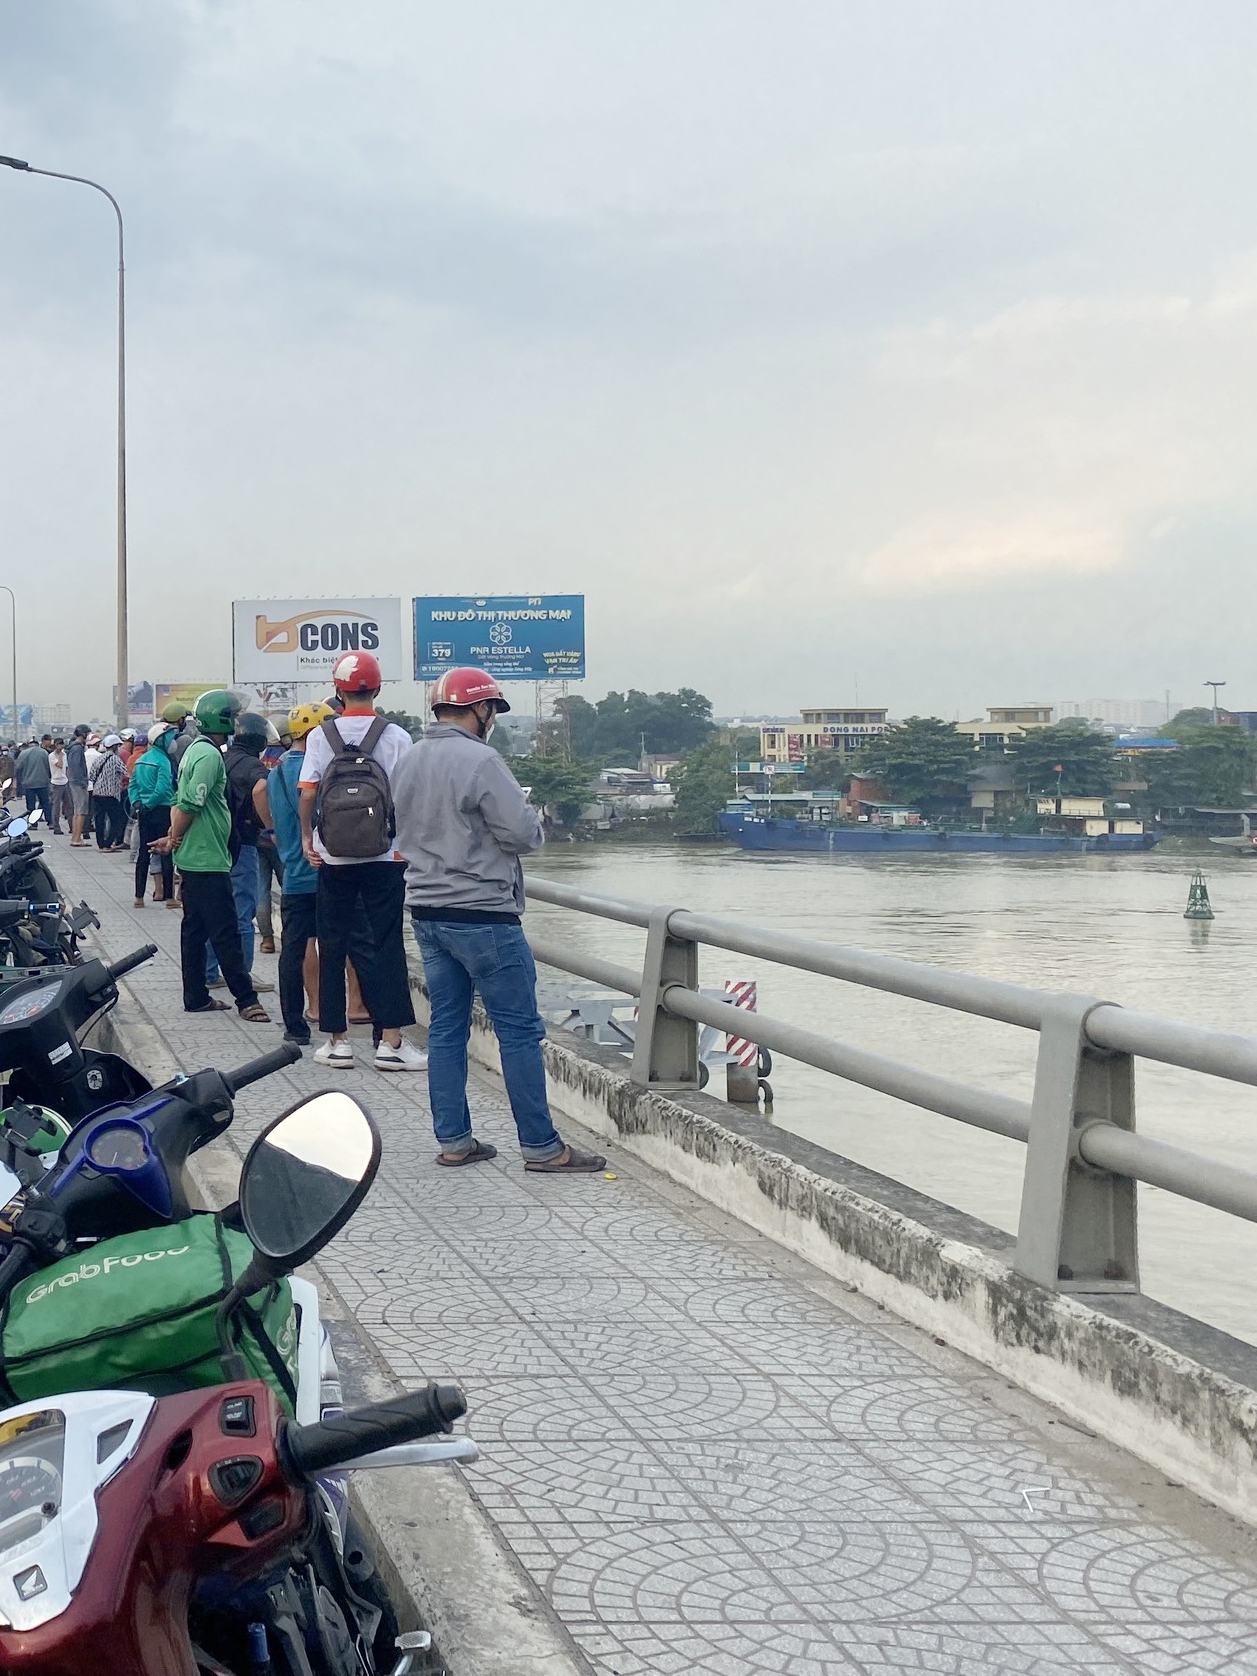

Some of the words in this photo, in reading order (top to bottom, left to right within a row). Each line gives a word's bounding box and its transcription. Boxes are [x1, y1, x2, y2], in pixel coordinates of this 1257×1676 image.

[431, 610, 456, 621] KHU
[457, 609, 475, 621] ĐÔ
[476, 610, 496, 623] THỊ
[497, 609, 548, 620] THƯƠNG
[548, 609, 572, 621] MẠI
[432, 649, 451, 657] 379
[470, 646, 489, 654] PNR
[491, 646, 532, 654] ESTELLA
